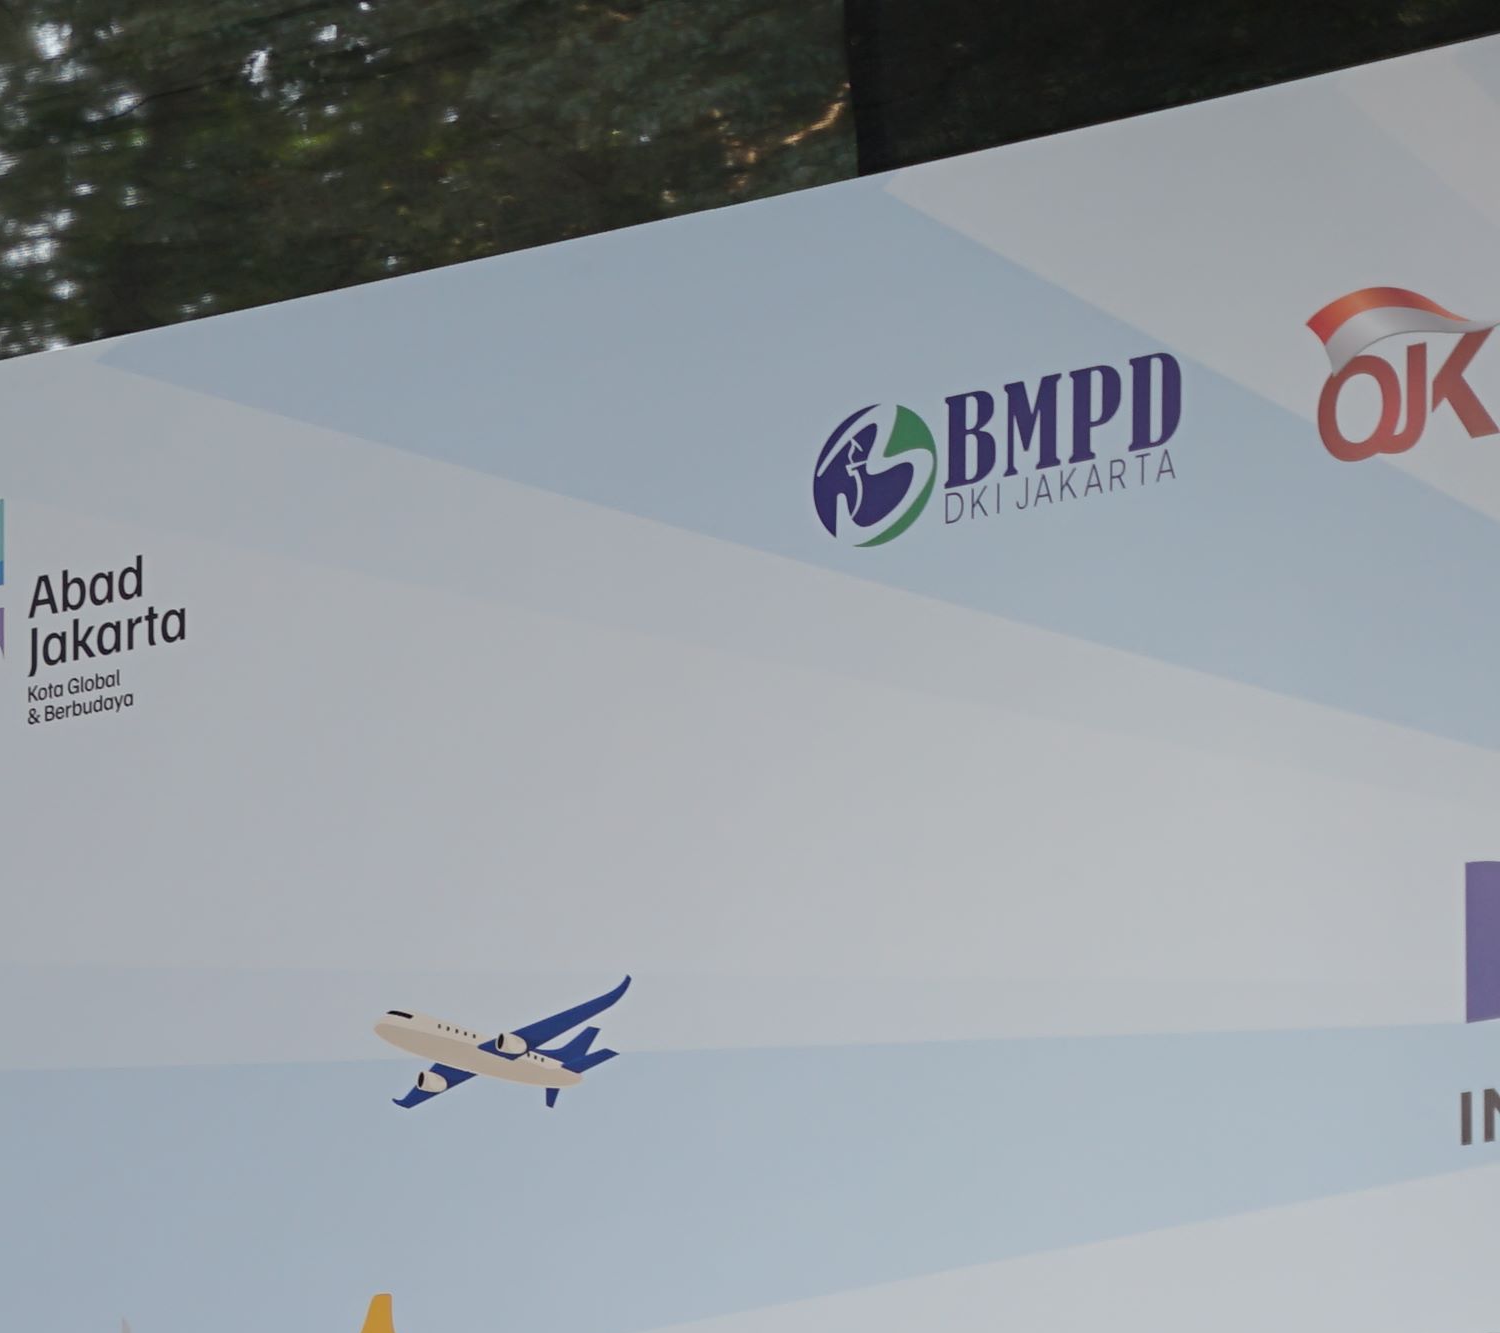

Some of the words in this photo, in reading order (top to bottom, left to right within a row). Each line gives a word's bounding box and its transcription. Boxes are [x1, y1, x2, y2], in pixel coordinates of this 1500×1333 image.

[943, 352, 1182, 490] BMPD
[1317, 328, 1500, 463] OJK
[944, 482, 1002, 525] DKI
[1015, 448, 1177, 510] JAKARTA
[27, 554, 143, 620] Abad
[27, 606, 187, 677] Jakarta
[27, 681, 64, 704] Kota
[67, 669, 121, 696] Global
[27, 707, 41, 726] &
[44, 692, 134, 723] Berbudaya
